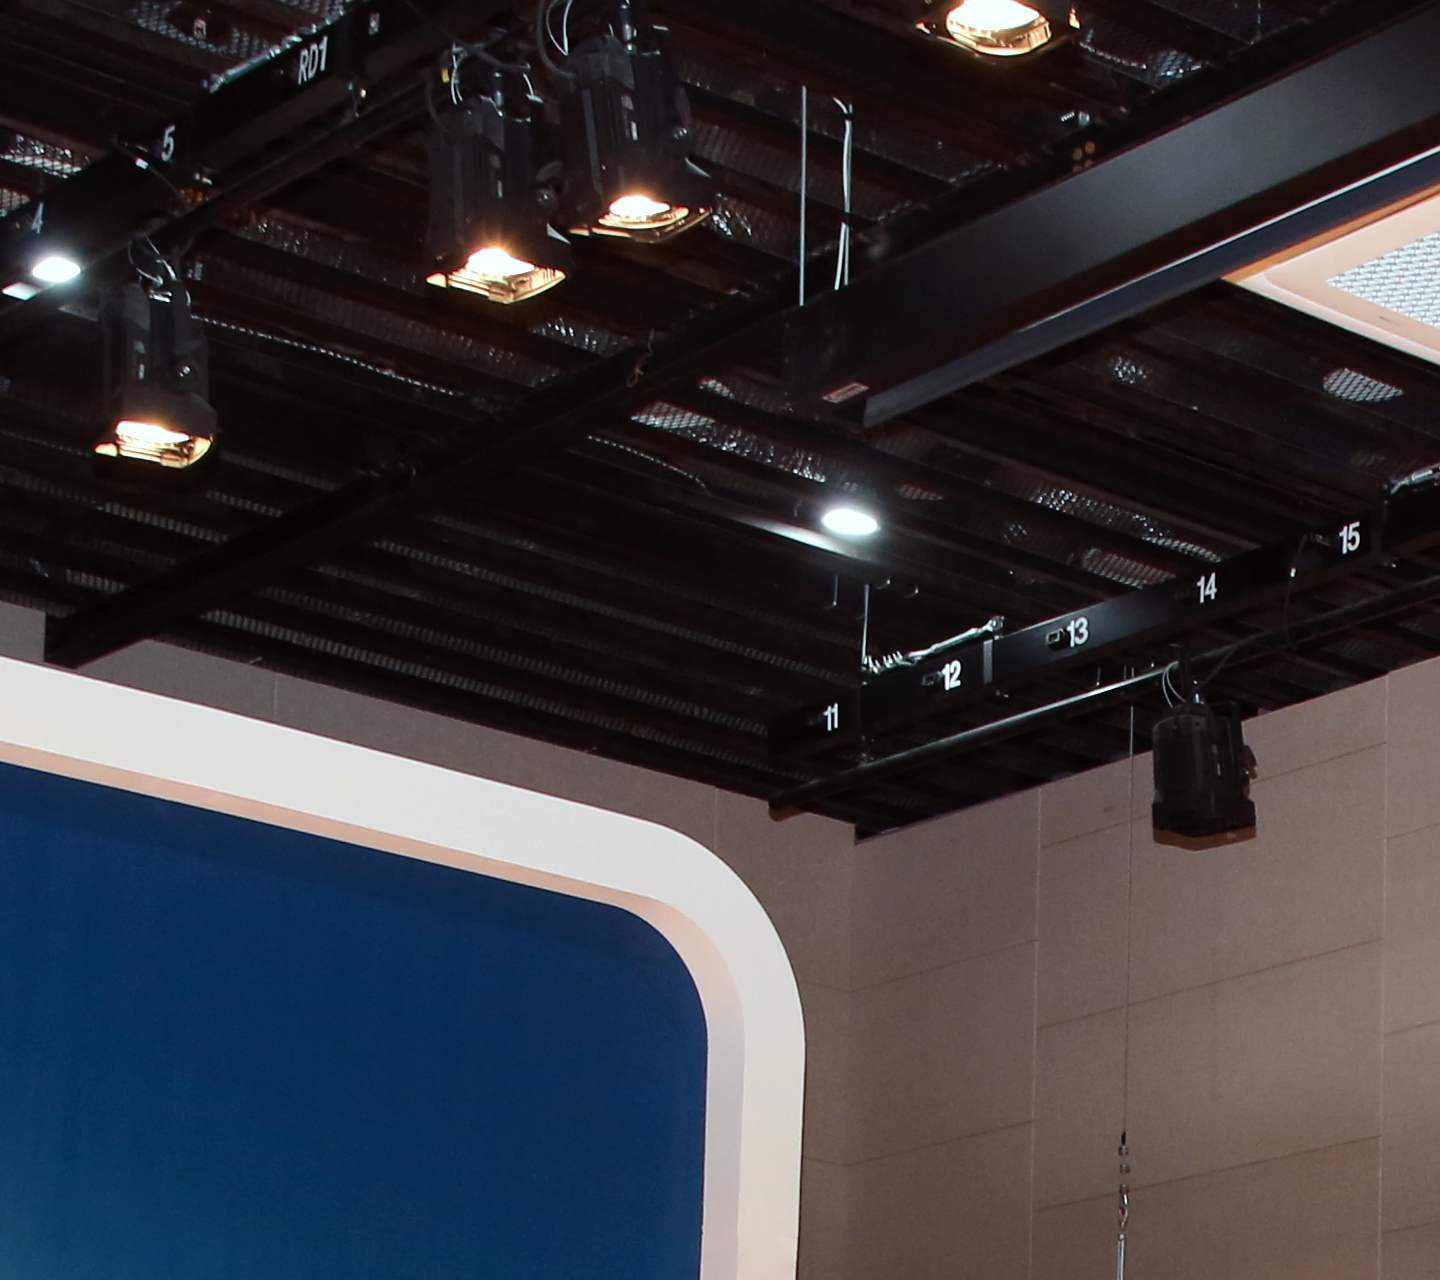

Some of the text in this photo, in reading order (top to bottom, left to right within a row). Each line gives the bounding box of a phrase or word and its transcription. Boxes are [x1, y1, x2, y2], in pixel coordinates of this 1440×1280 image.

[298, 36, 328, 84] RD1
[161, 126, 175, 161] 5
[1339, 522, 1360, 554] 15
[1197, 573, 1217, 603] 14
[1067, 617, 1088, 647] 13
[942, 661, 961, 690] 12
[824, 704, 838, 731] 11
